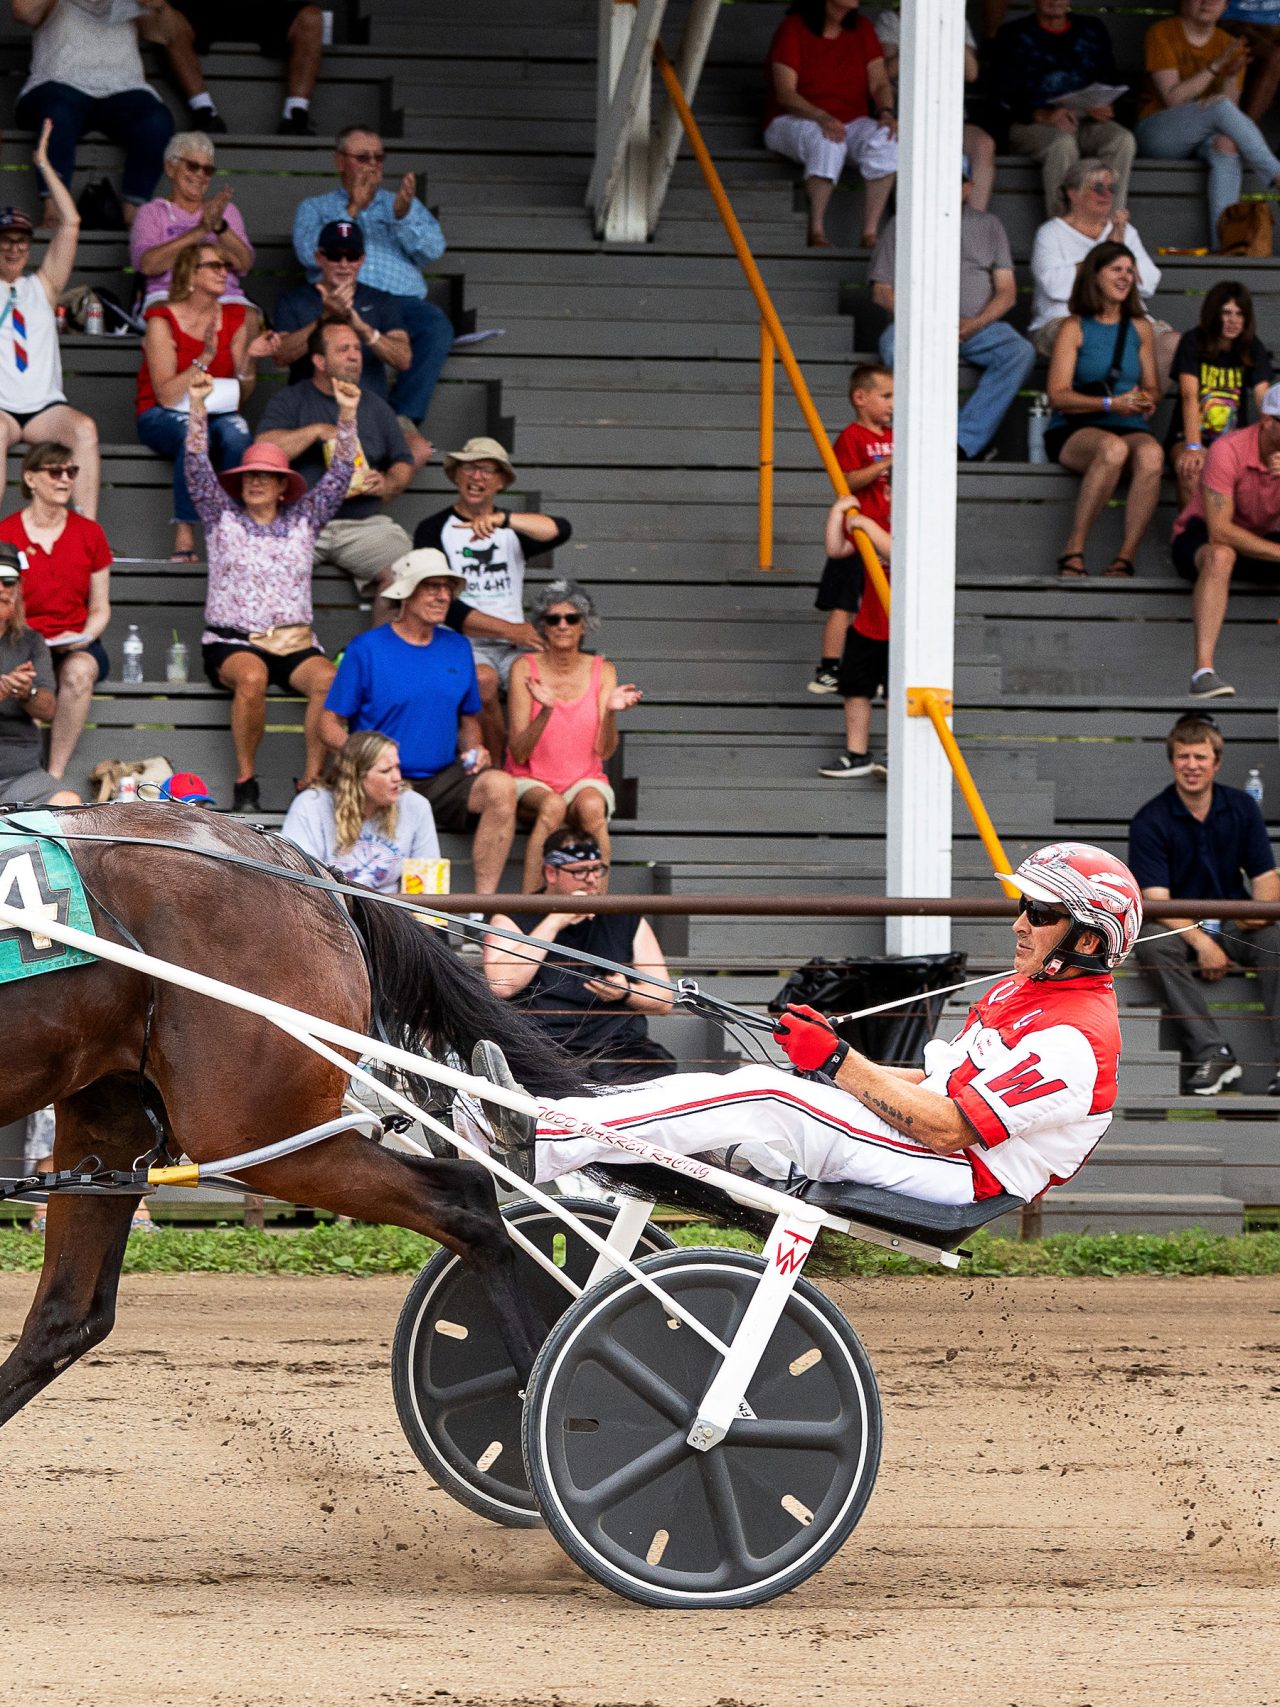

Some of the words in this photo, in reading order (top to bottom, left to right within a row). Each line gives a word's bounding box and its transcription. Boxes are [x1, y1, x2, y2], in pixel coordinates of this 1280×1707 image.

[984, 1051, 1068, 1108] W
[537, 1106, 578, 1129] TODD
[580, 1122, 650, 1156] WARREN
[649, 1147, 711, 1179] RACING
